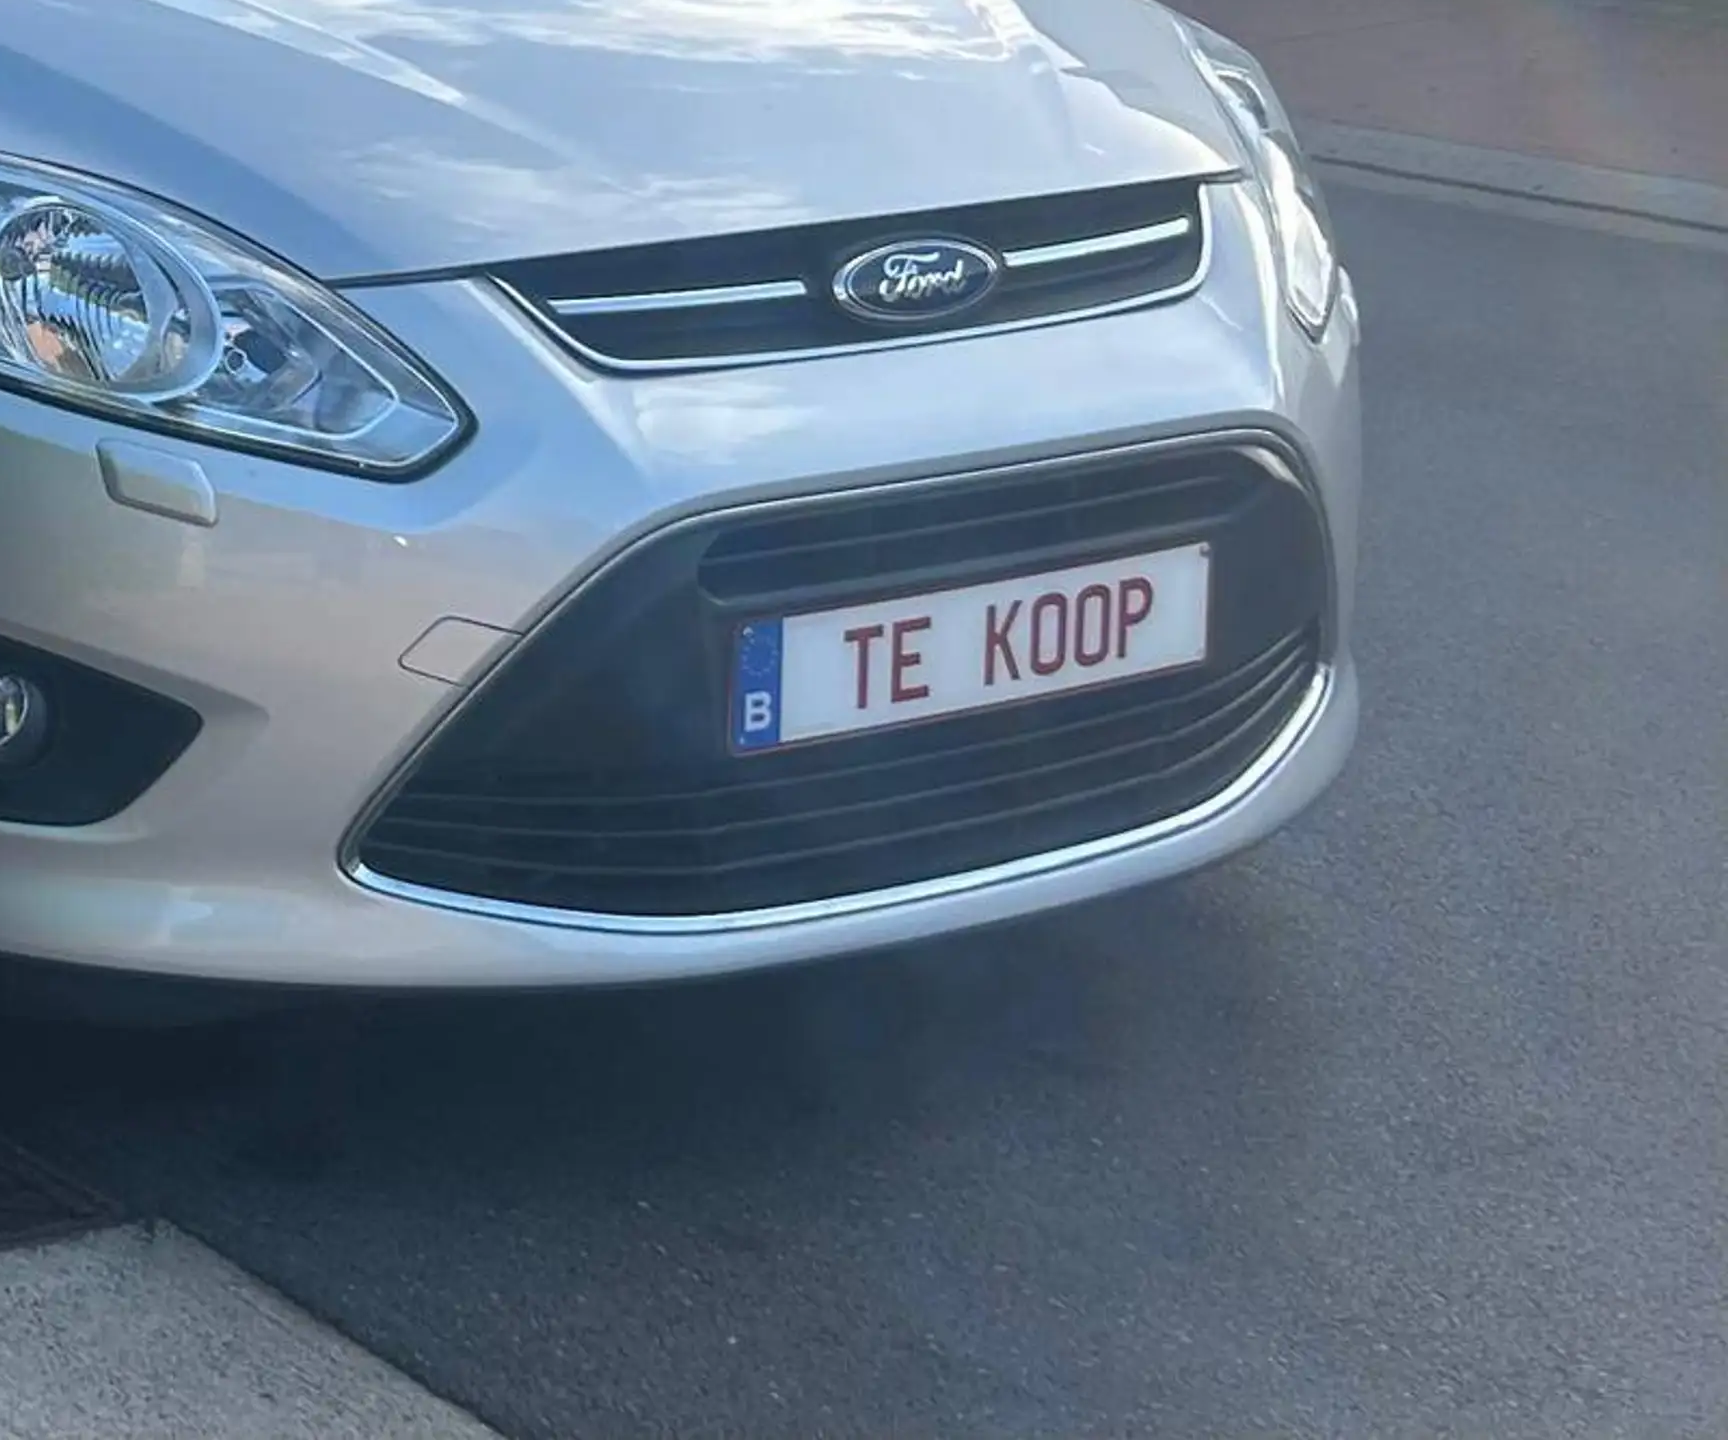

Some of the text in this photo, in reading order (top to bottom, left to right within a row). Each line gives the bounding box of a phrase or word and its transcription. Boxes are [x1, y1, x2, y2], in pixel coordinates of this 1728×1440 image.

[879, 250, 967, 303] Ford
[843, 576, 1154, 710] TE KOOP
[743, 691, 773, 733] B
